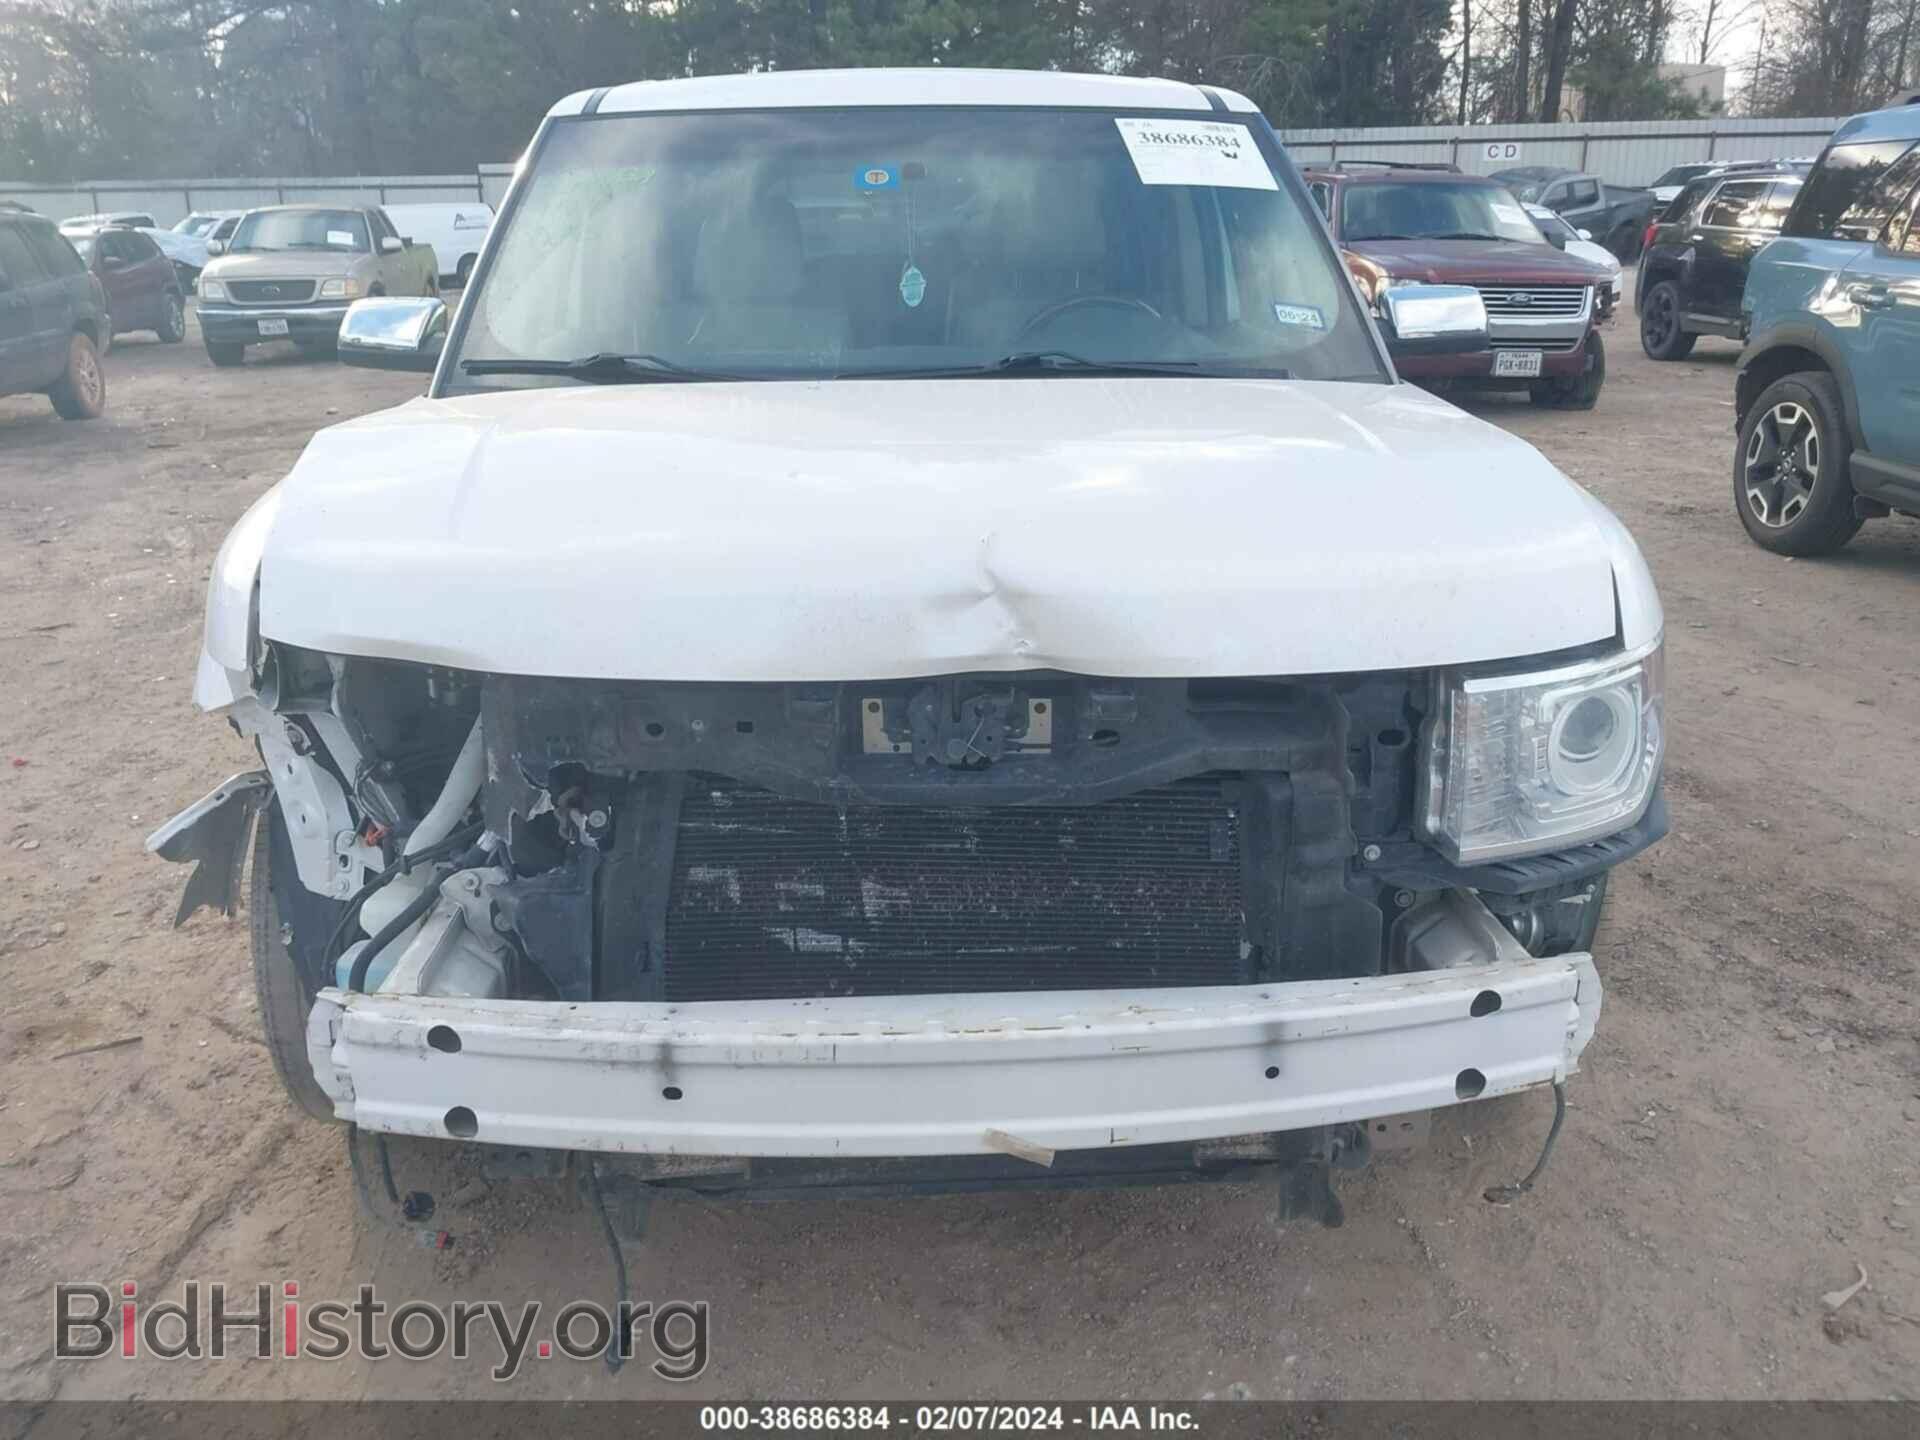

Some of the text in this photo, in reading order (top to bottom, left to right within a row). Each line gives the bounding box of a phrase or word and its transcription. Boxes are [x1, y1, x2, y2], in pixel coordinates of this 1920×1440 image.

[1137, 131, 1241, 149] 38686384
[1488, 144, 1517, 159] C D
